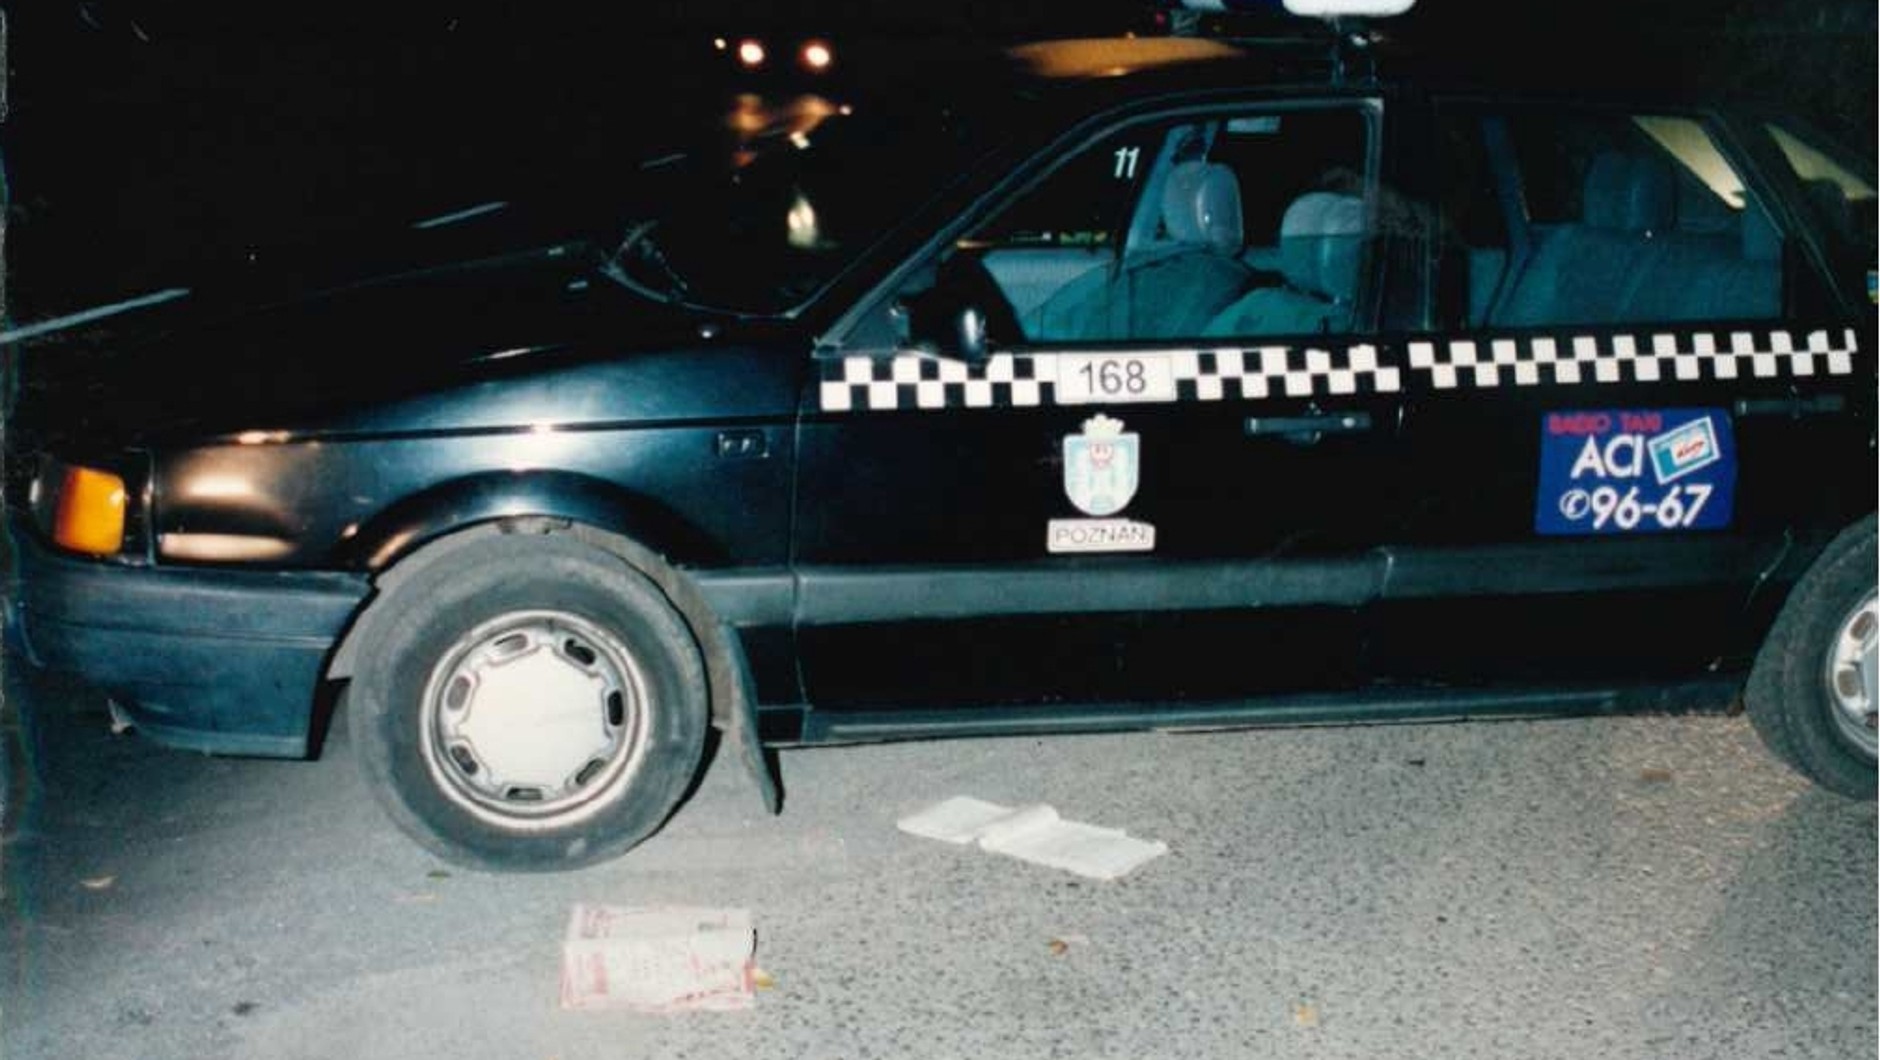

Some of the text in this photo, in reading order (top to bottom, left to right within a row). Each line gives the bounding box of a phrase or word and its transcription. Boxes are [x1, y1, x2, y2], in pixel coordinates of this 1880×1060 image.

[1079, 359, 1146, 395] 168
[1619, 412, 1662, 433] TAXI
[1570, 433, 1645, 480] ACI
[1591, 484, 1713, 530] 96-67
